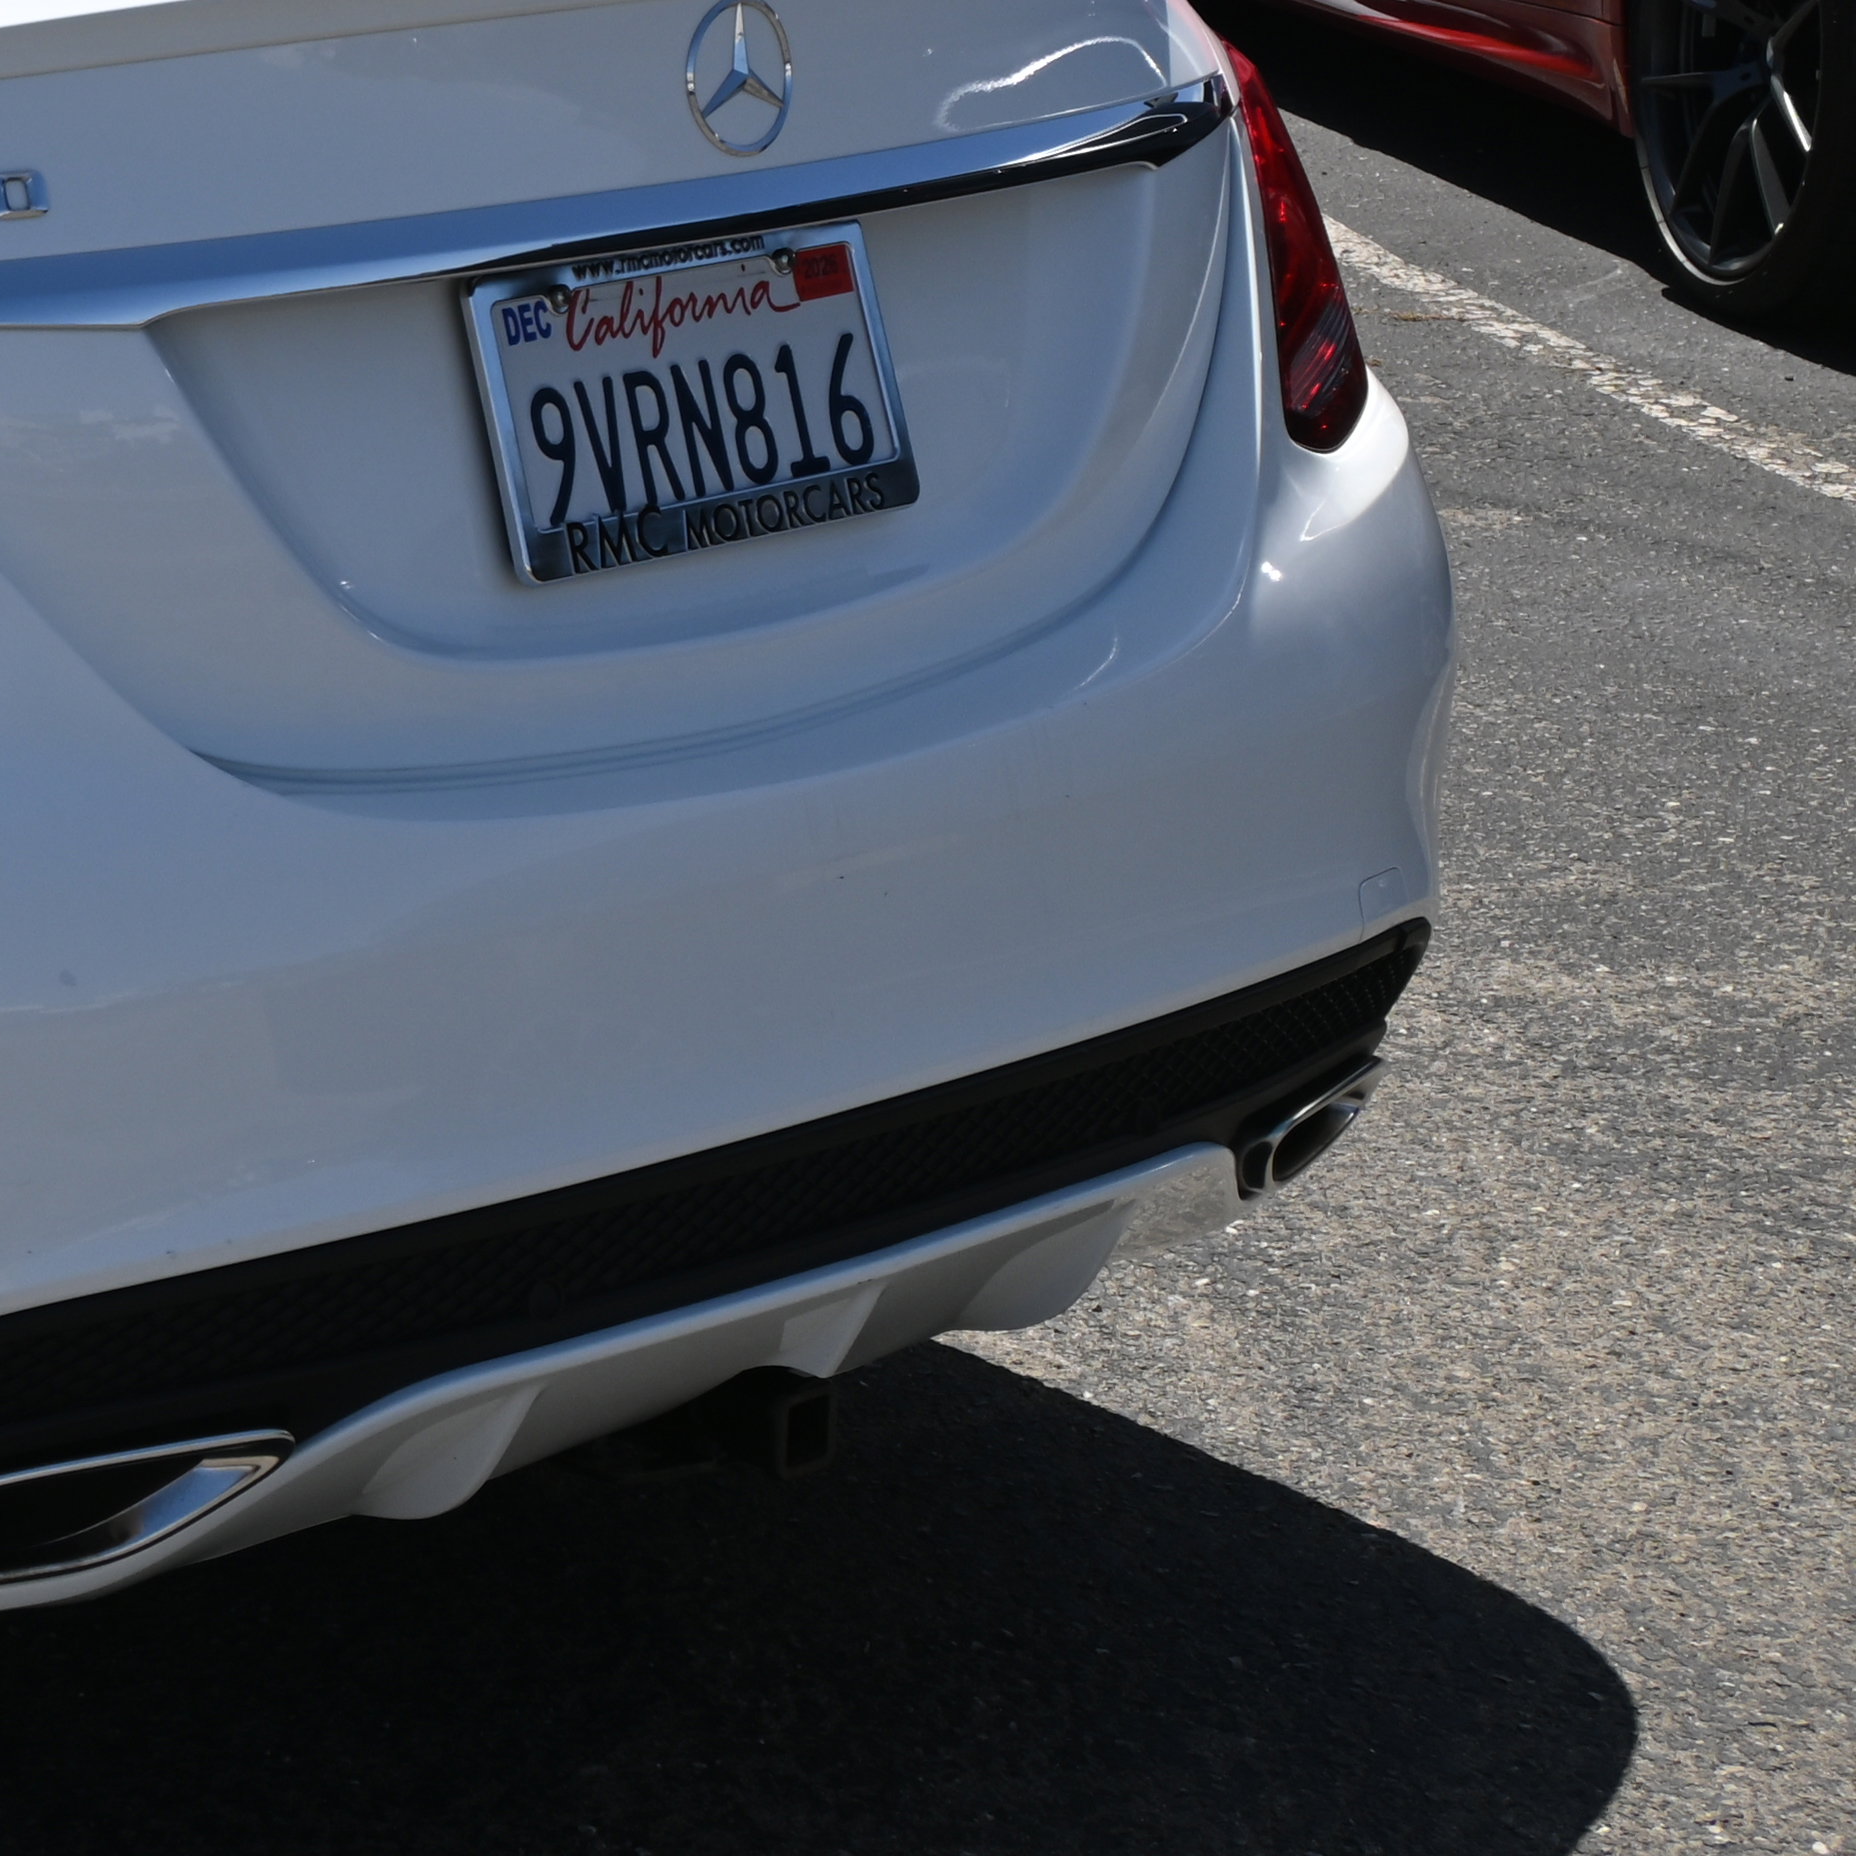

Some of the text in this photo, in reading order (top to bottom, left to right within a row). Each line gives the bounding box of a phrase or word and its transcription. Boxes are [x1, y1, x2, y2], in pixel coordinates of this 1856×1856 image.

[571, 235, 765, 281] www.rmcmotorcars.com
[500, 300, 553, 346] DEC
[564, 262, 801, 358] California
[529, 332, 875, 528] 9VRN816
[566, 471, 886, 575] RMC MOTORCARS
